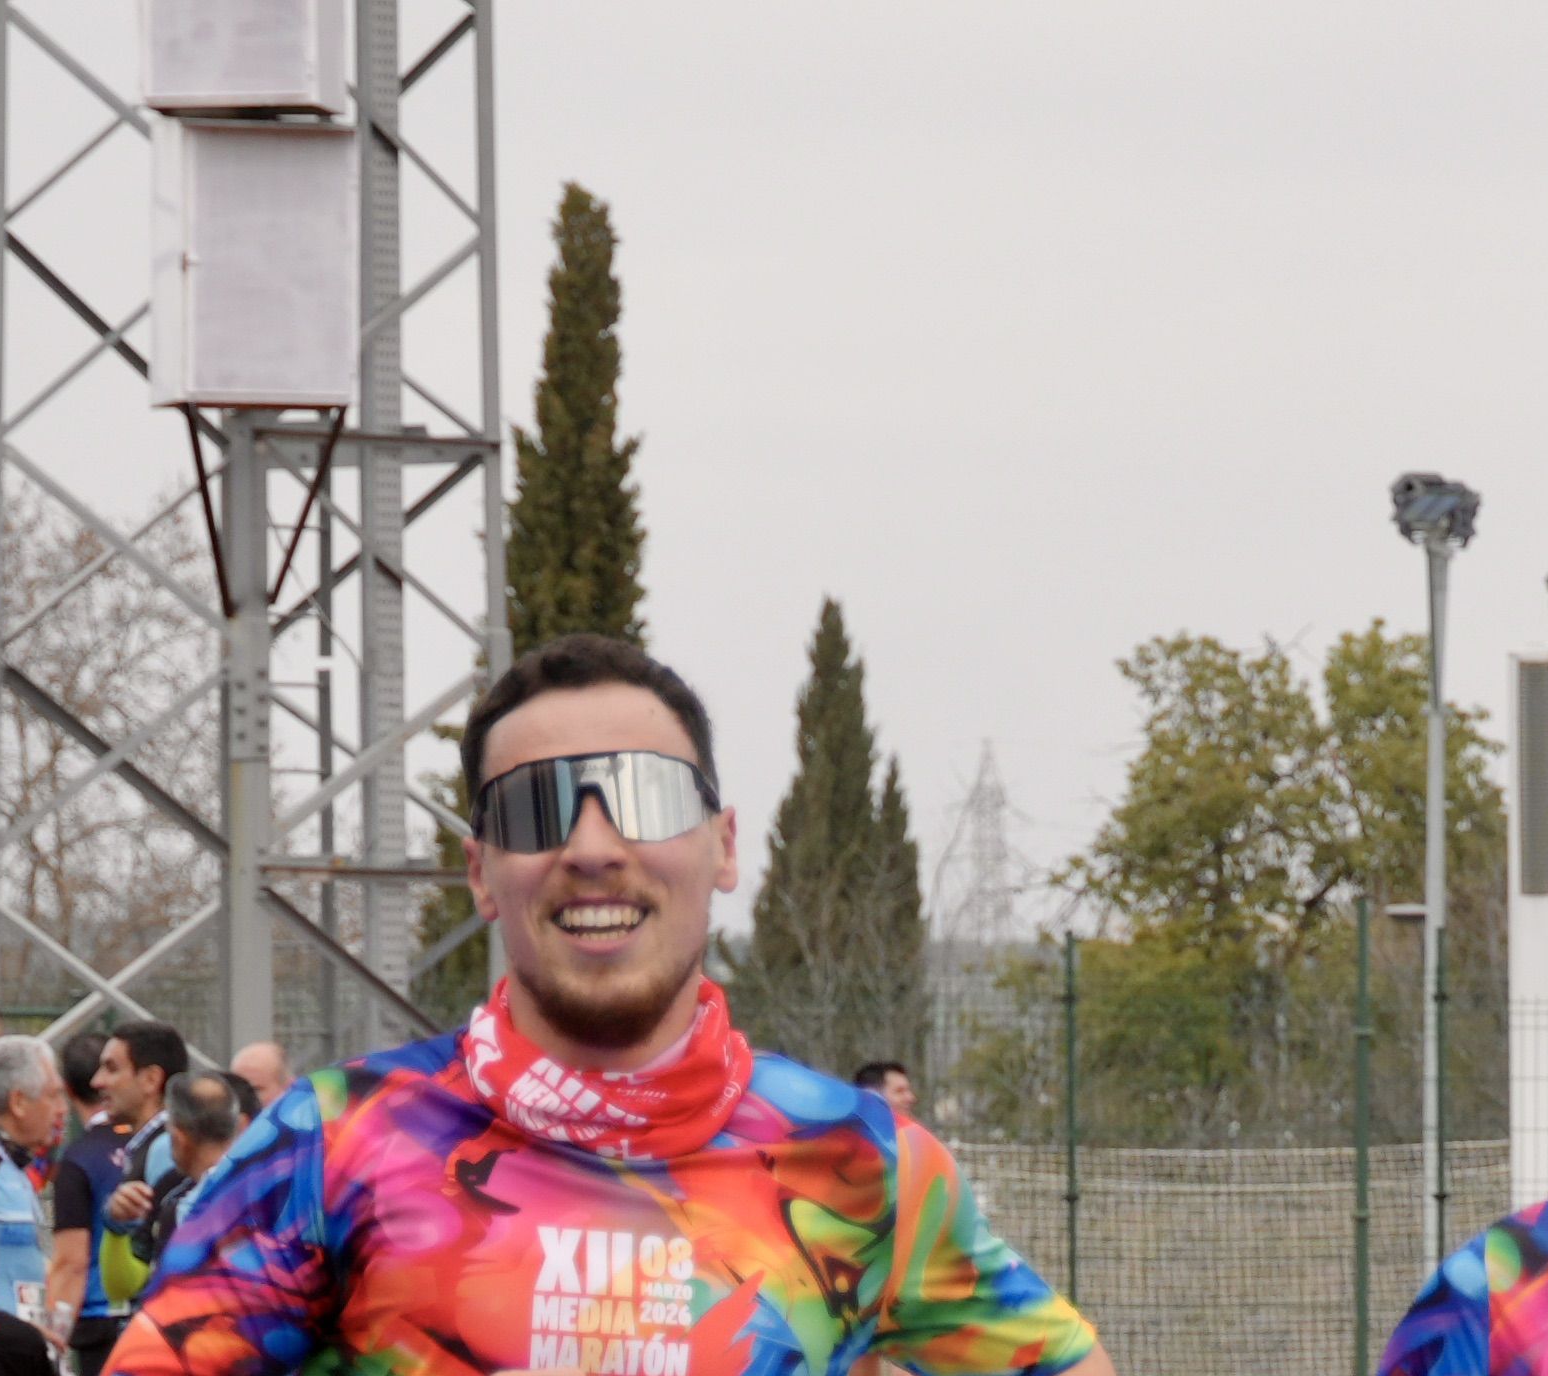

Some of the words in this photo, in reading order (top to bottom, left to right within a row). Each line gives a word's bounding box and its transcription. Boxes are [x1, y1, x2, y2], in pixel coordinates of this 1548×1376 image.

[534, 1225, 634, 1298] XII
[638, 1234, 694, 1280] 08
[640, 1281, 694, 1301] MARZO
[532, 1294, 636, 1336] MEDIA
[639, 1300, 693, 1327] 2026
